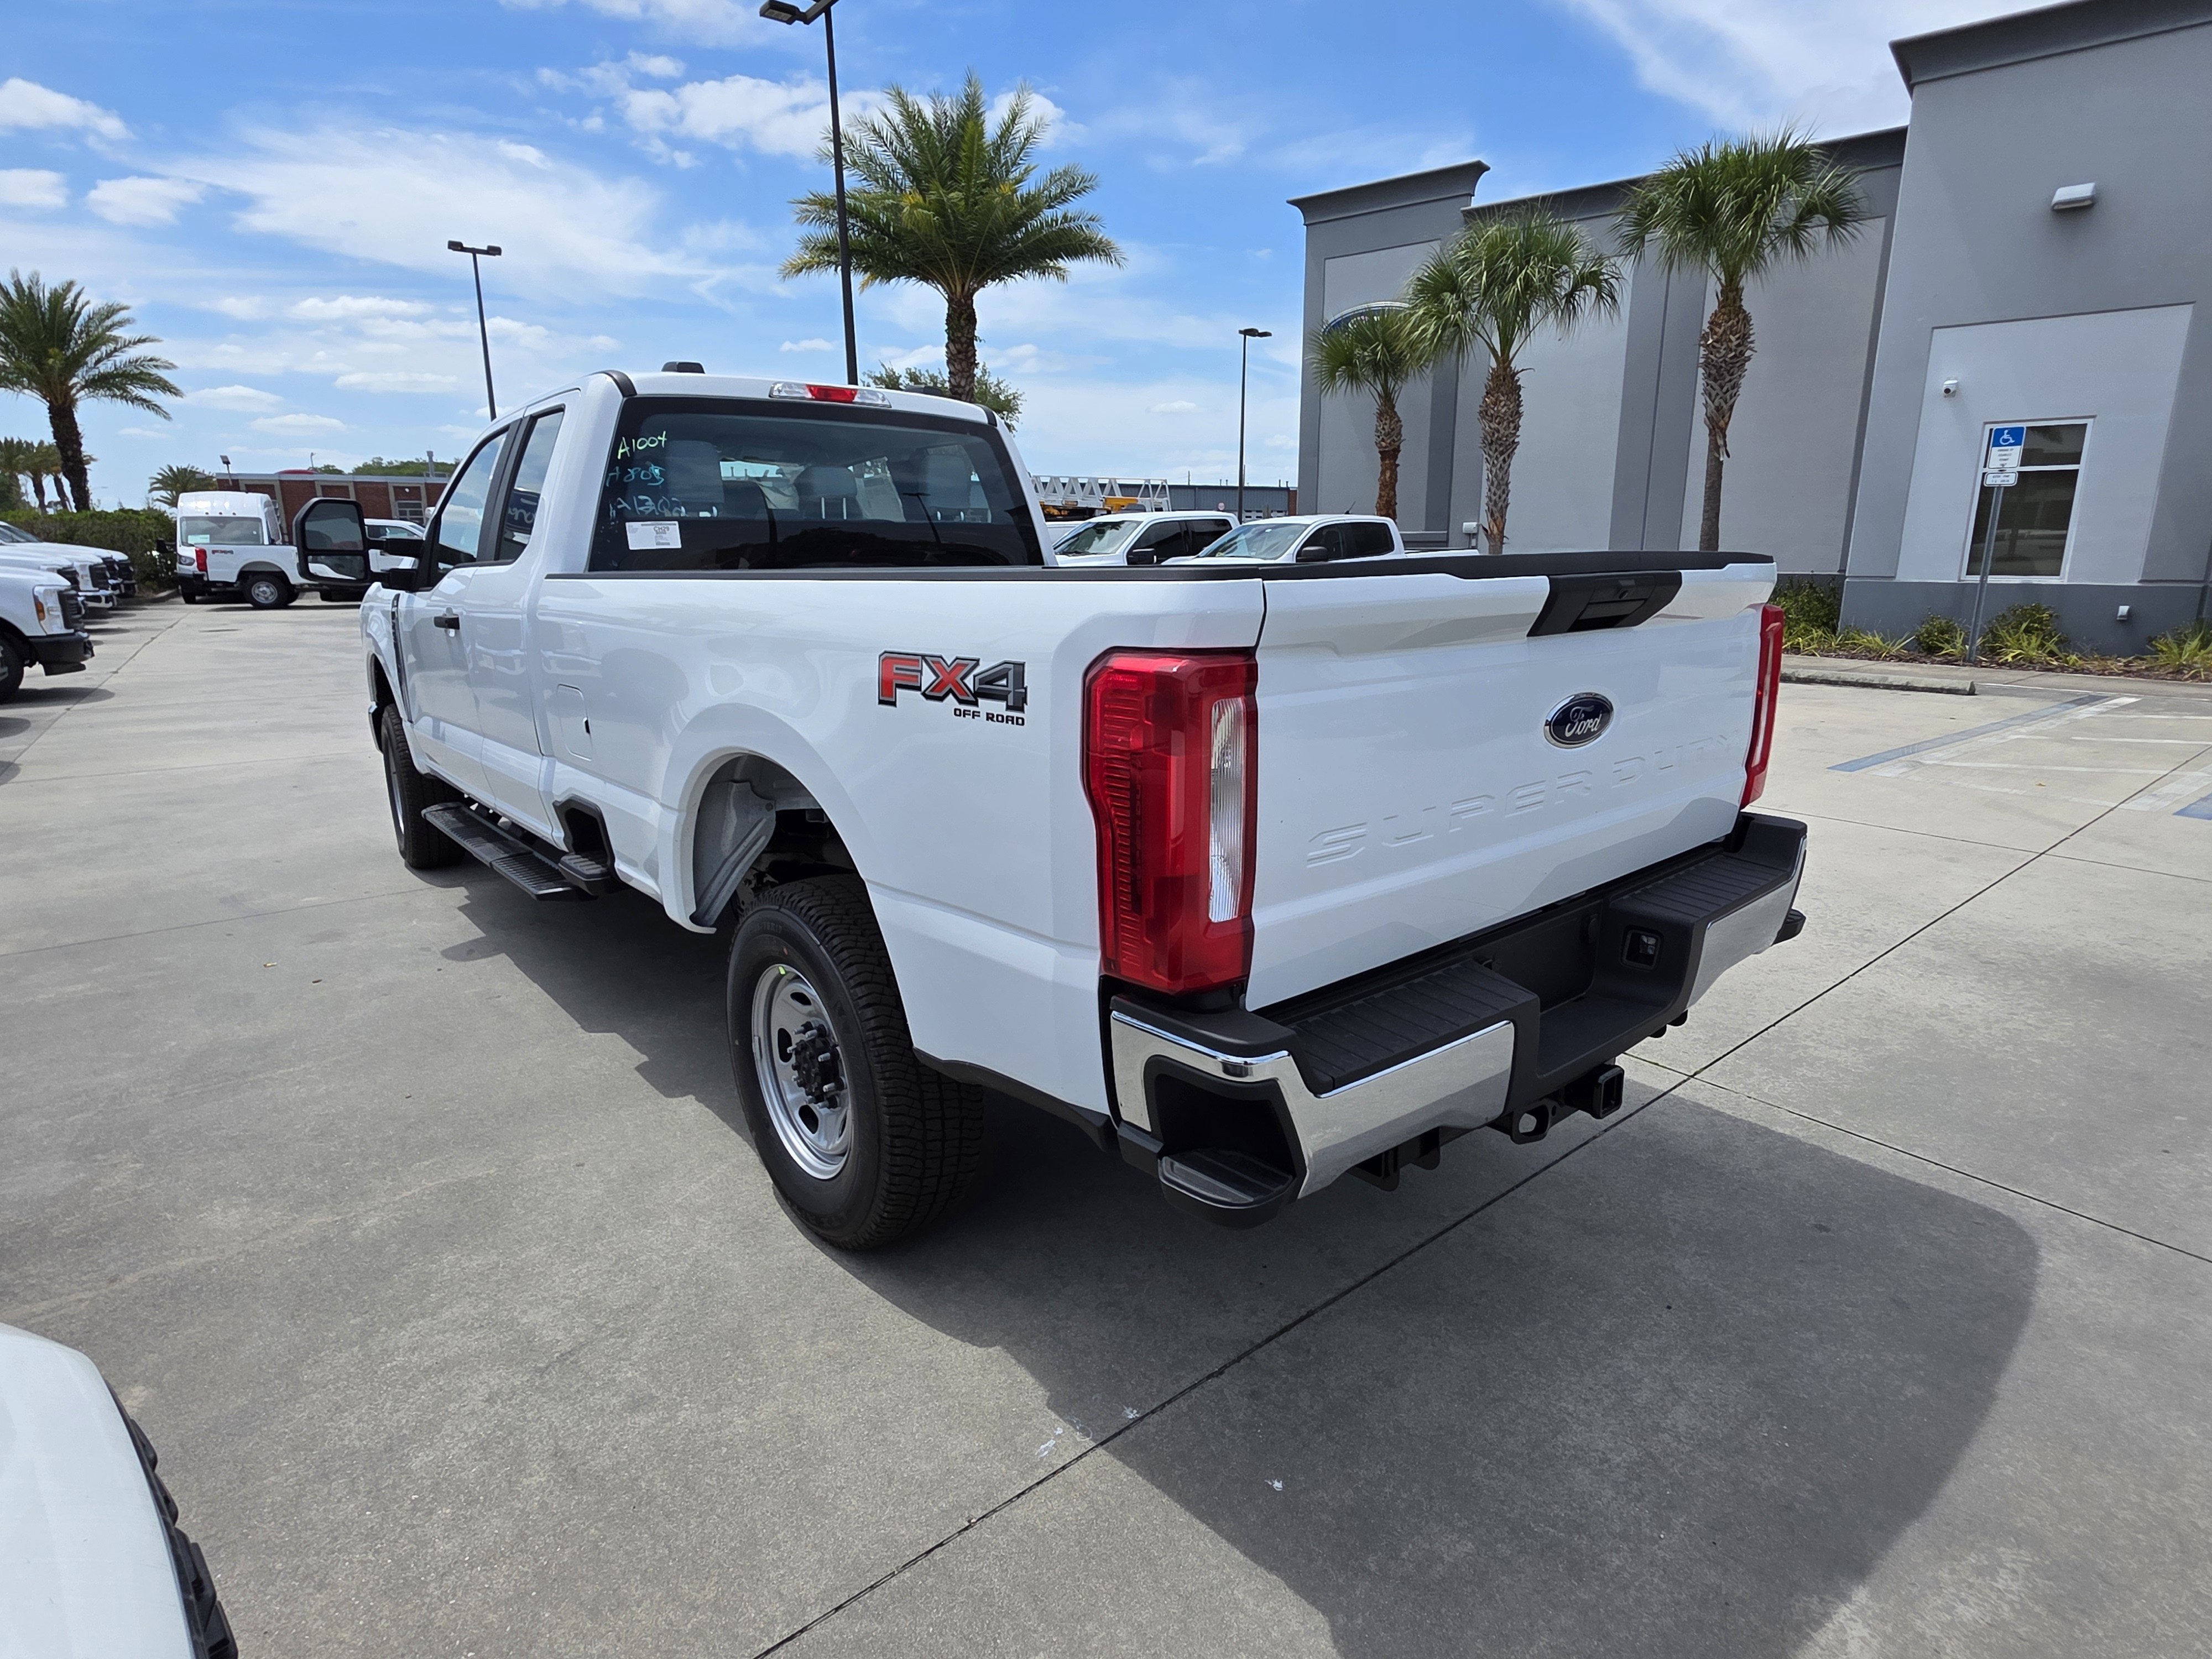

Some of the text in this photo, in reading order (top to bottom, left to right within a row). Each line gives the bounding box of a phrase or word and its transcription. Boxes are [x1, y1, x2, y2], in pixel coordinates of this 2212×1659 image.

[617, 431, 667, 460] A1004
[878, 650, 1027, 714] FX4
[953, 708, 1025, 726] OFF ROAD
[1564, 705, 1603, 738] Ford
[1306, 770, 1593, 868] SUPER
